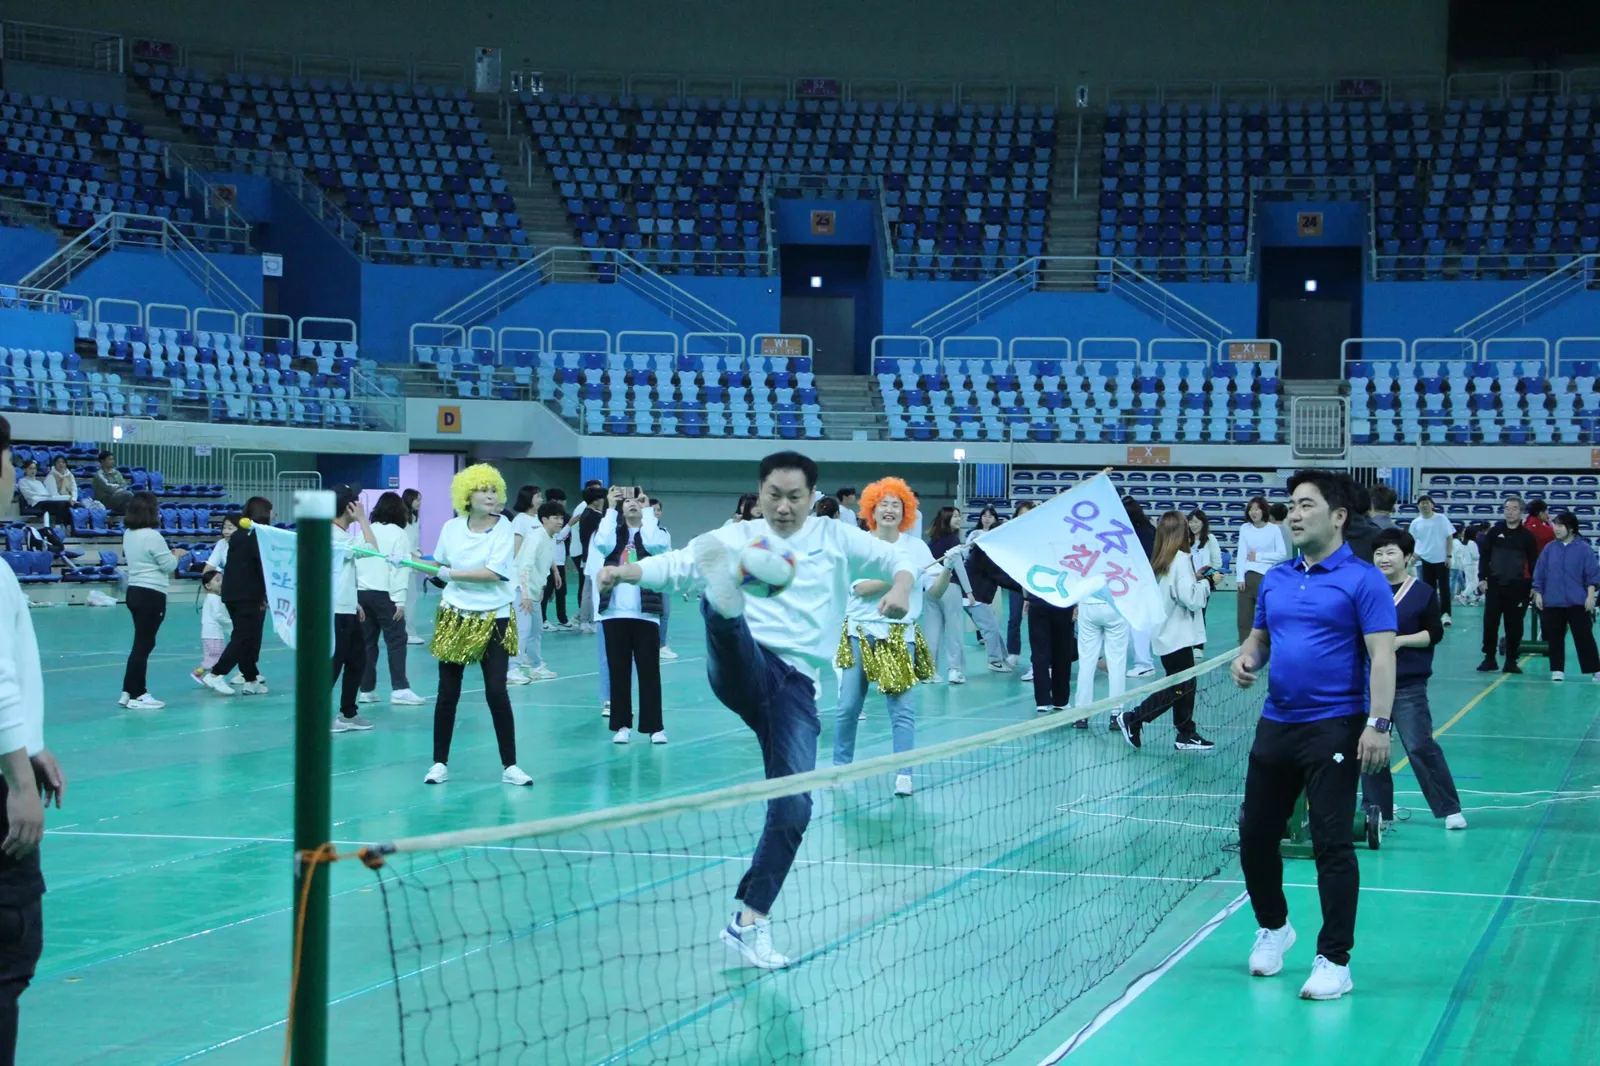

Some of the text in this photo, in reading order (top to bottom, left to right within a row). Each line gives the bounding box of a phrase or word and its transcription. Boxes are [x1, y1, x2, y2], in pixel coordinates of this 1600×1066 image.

[816, 214, 830, 226] 23
[1302, 215, 1317, 227] 24
[63, 299, 73, 310] V1
[774, 338, 789, 348] W1
[1243, 343, 1256, 353] X1
[444, 412, 454, 426] D
[1144, 446, 1153, 457] X
[1063, 500, 1134, 554] 우주
[1059, 544, 1138, 597] 최강
